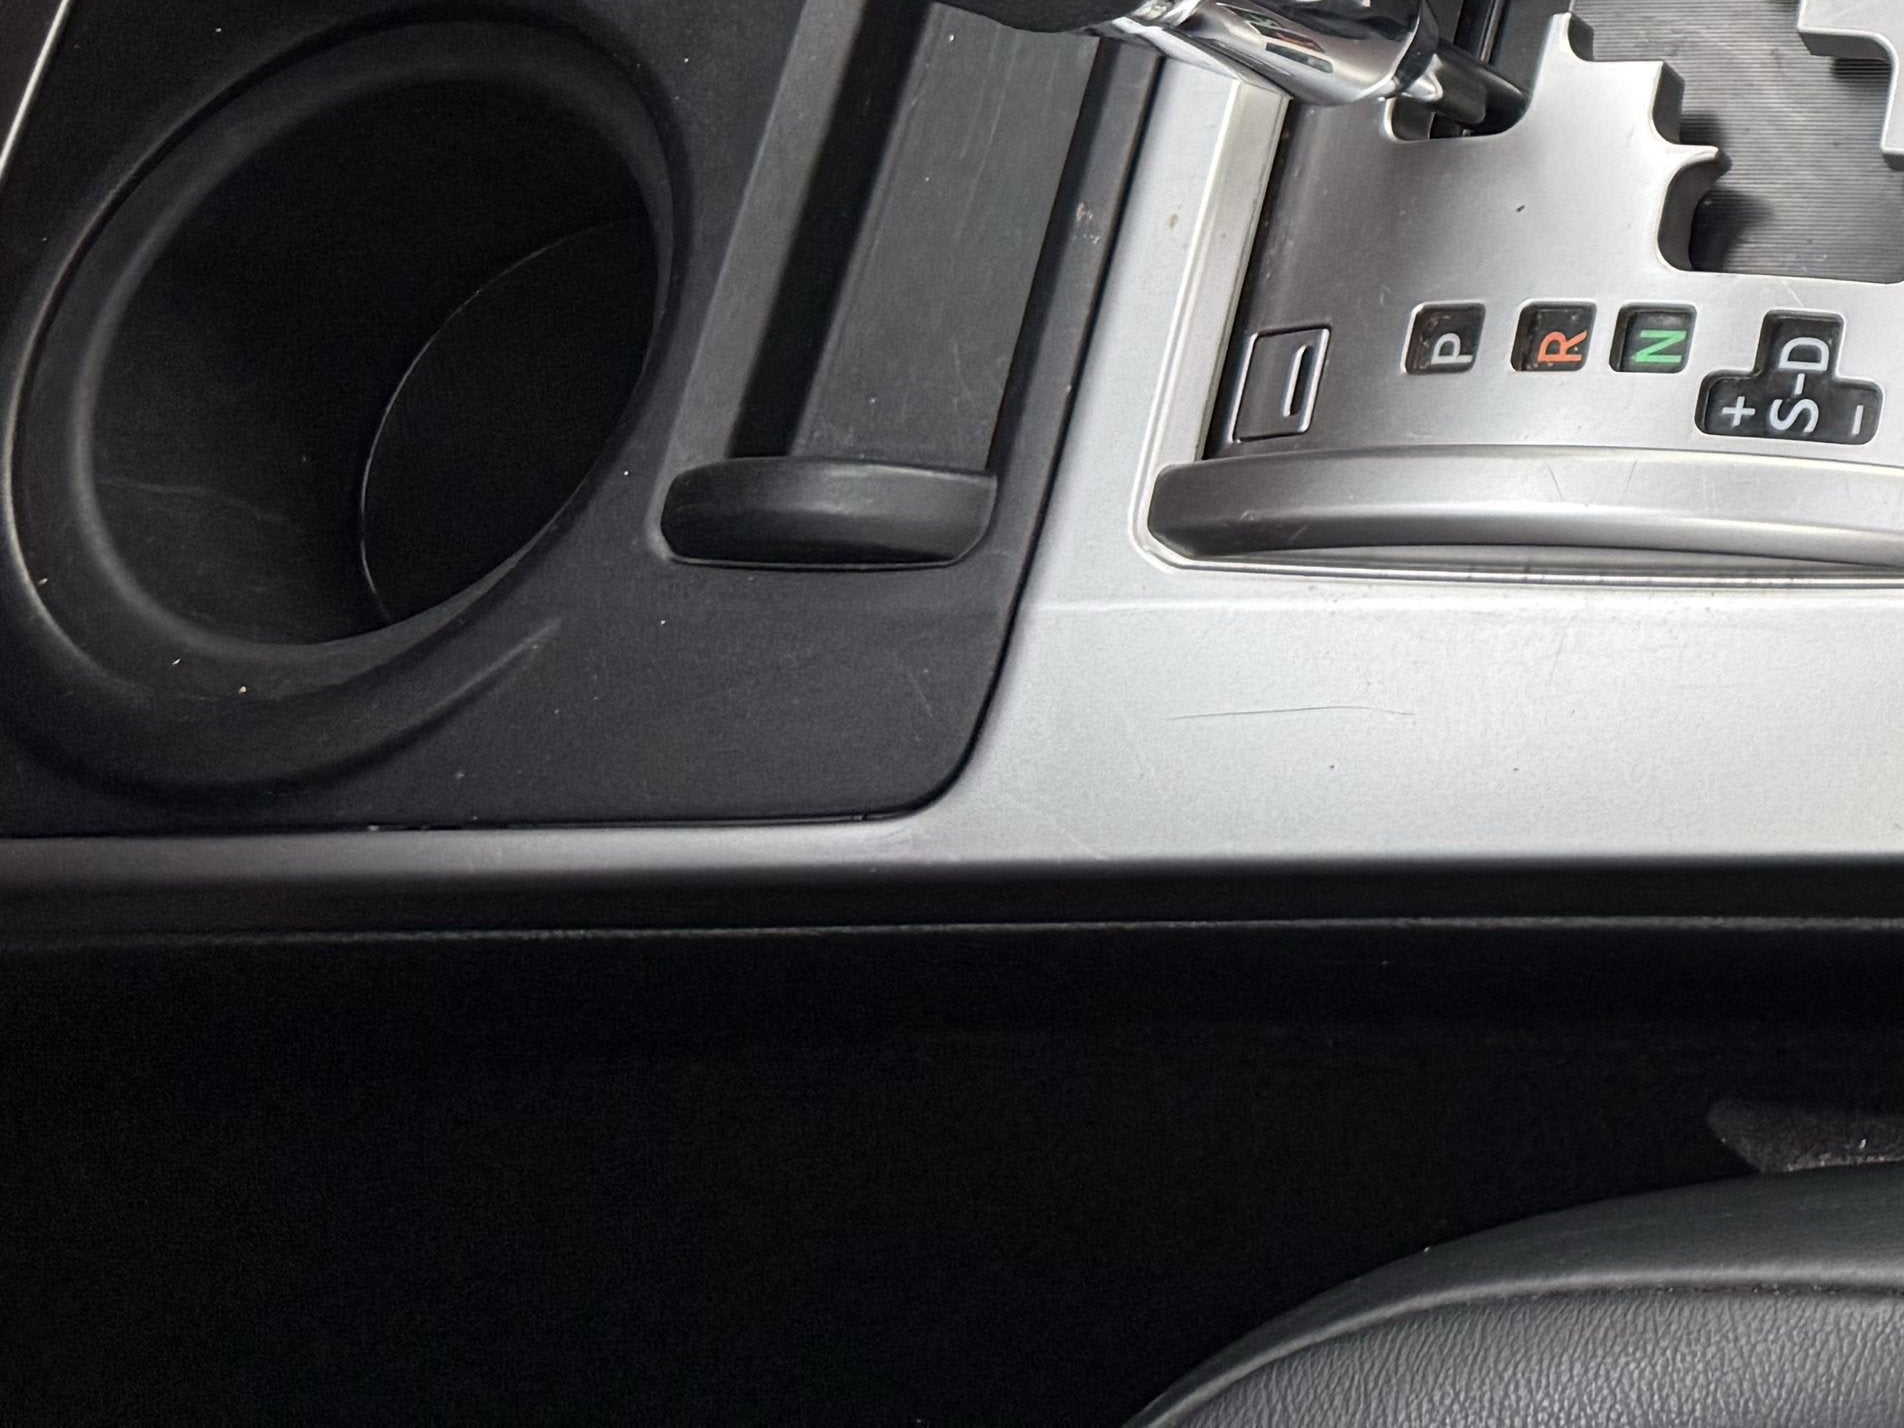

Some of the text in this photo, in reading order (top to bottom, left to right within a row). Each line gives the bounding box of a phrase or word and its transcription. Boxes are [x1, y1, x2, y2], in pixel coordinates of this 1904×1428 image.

[1430, 332, 1475, 366] P
[1538, 330, 1588, 363] R
[1635, 330, 1683, 362] N
